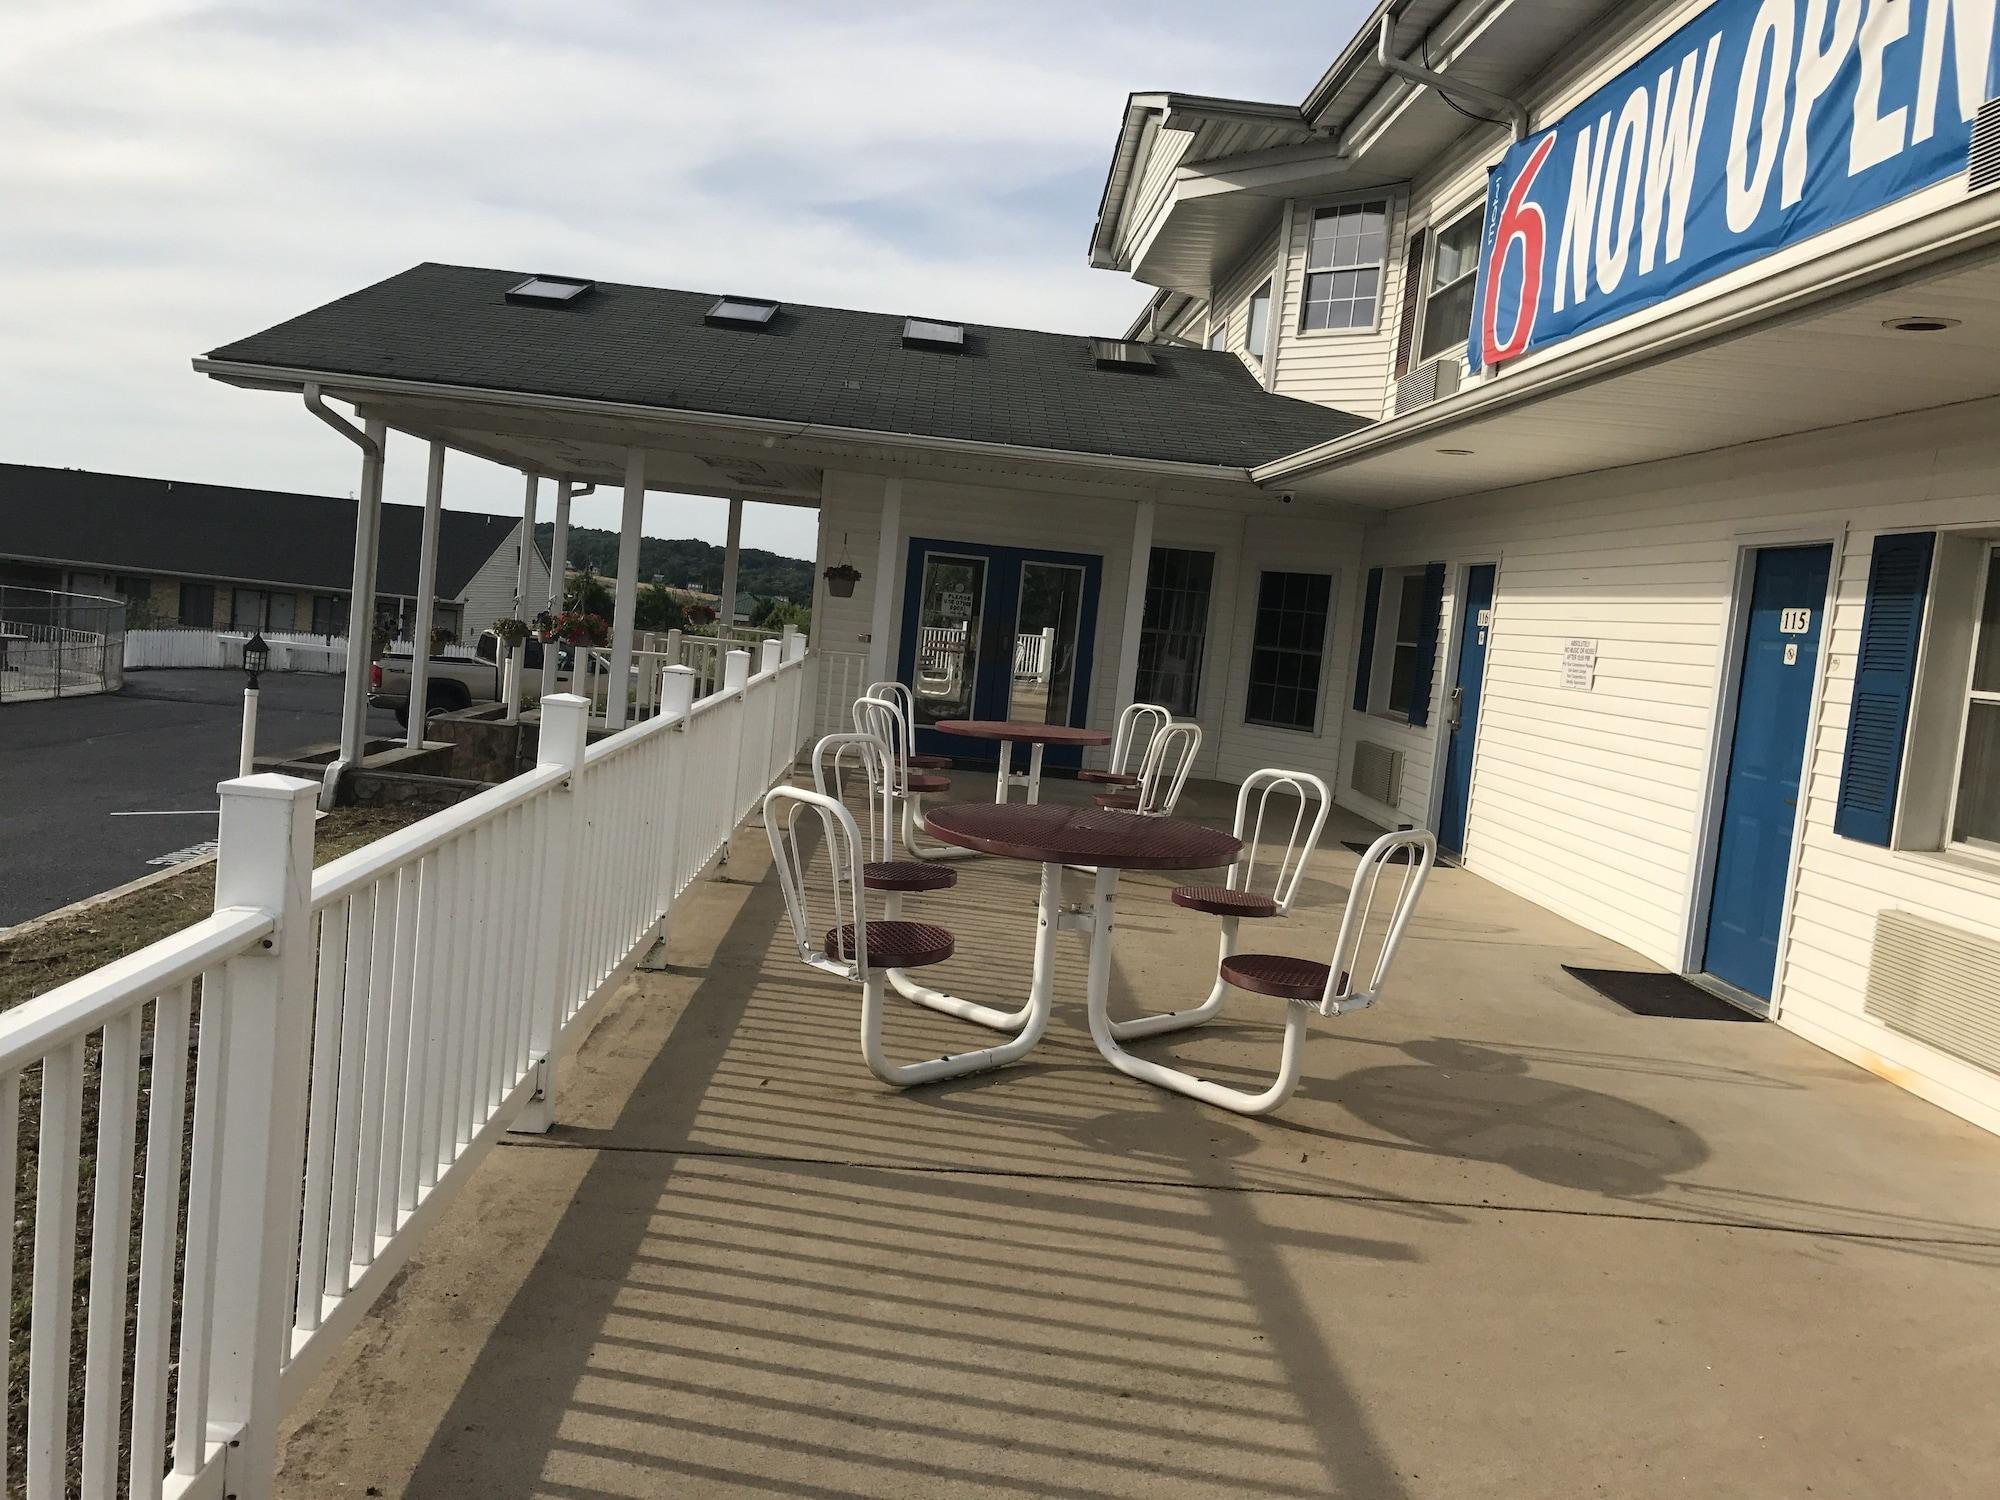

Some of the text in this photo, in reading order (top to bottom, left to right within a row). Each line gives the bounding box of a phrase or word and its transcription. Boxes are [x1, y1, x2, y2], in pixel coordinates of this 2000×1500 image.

[1482, 131, 1557, 365] 6
[1553, 31, 1722, 313] NOW
[1784, 611, 1807, 630] 115
